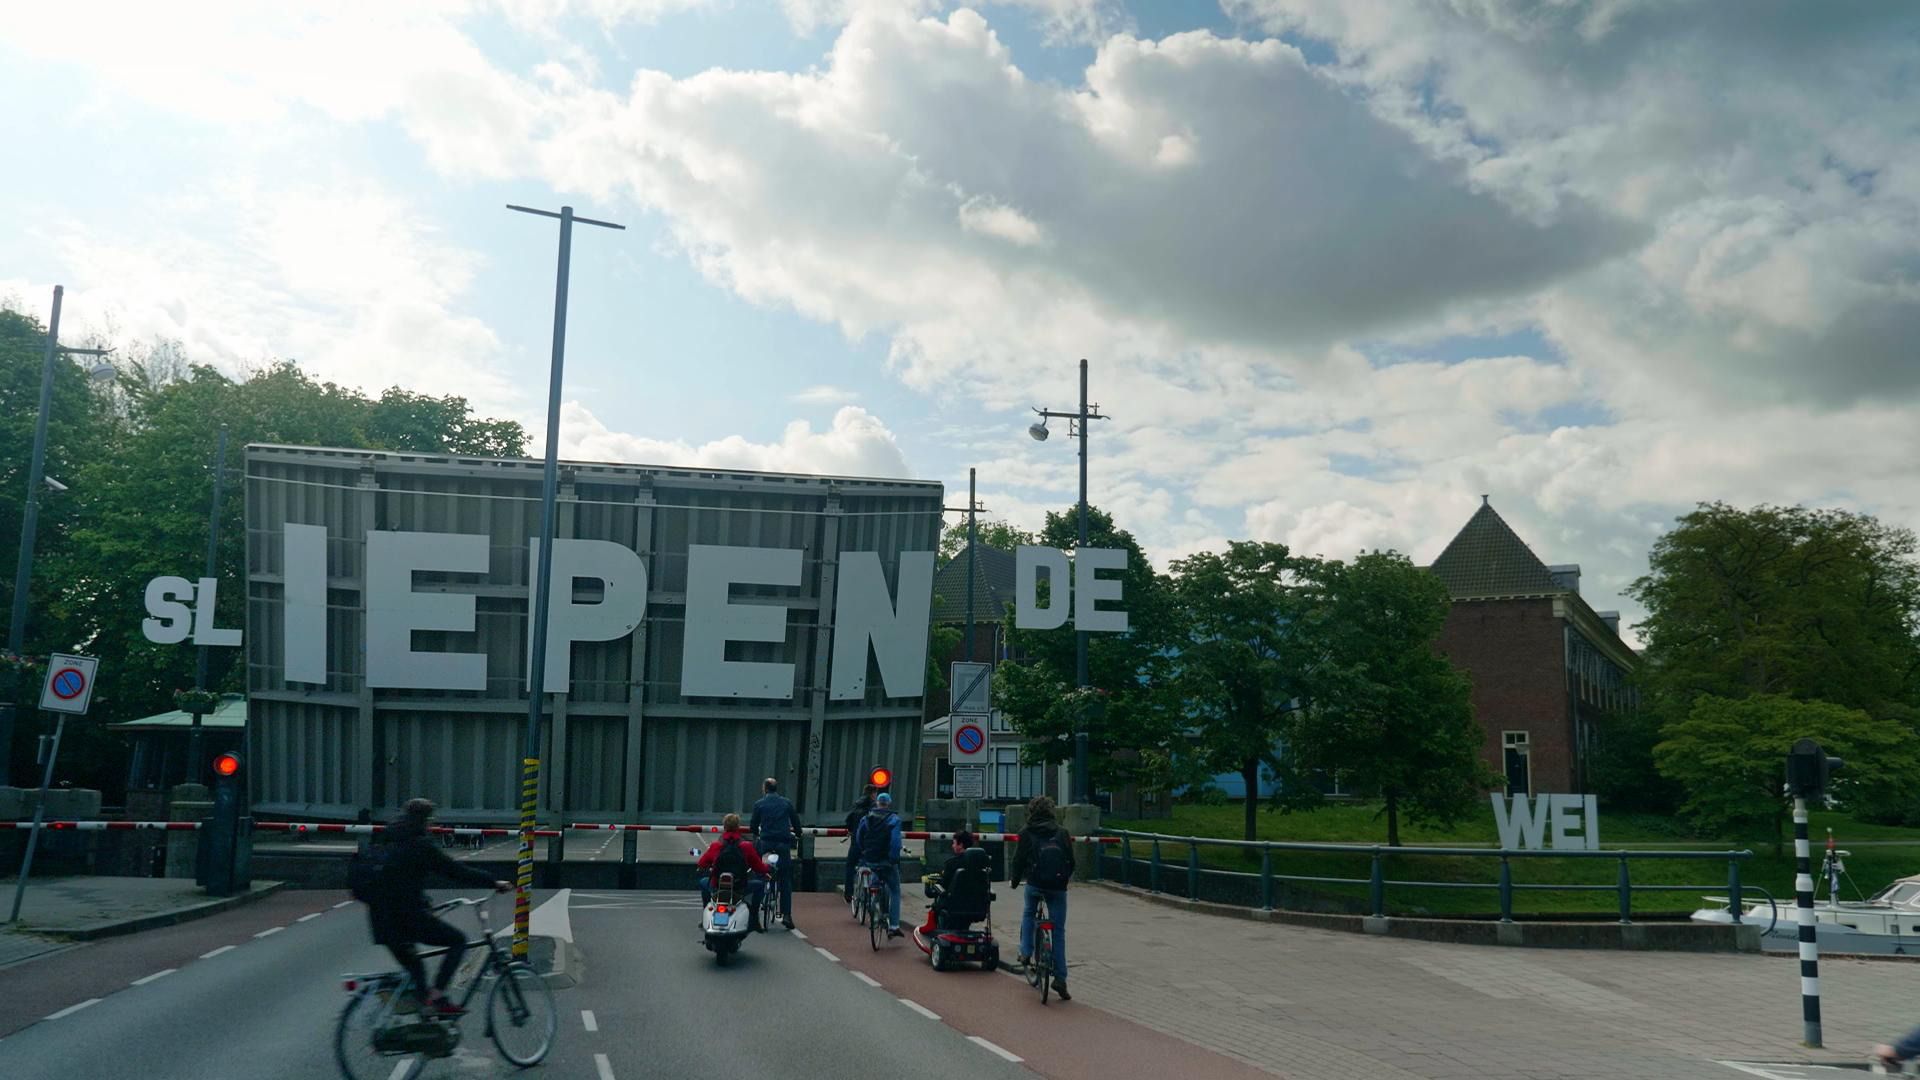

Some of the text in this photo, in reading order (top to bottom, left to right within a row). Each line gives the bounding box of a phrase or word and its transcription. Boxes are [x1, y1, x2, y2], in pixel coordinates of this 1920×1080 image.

[141, 576, 243, 646] SL
[283, 523, 934, 700] IEPEN
[1016, 545, 1129, 632] DE
[63, 659, 84, 667] ZONE
[1490, 792, 1600, 850] WEI
